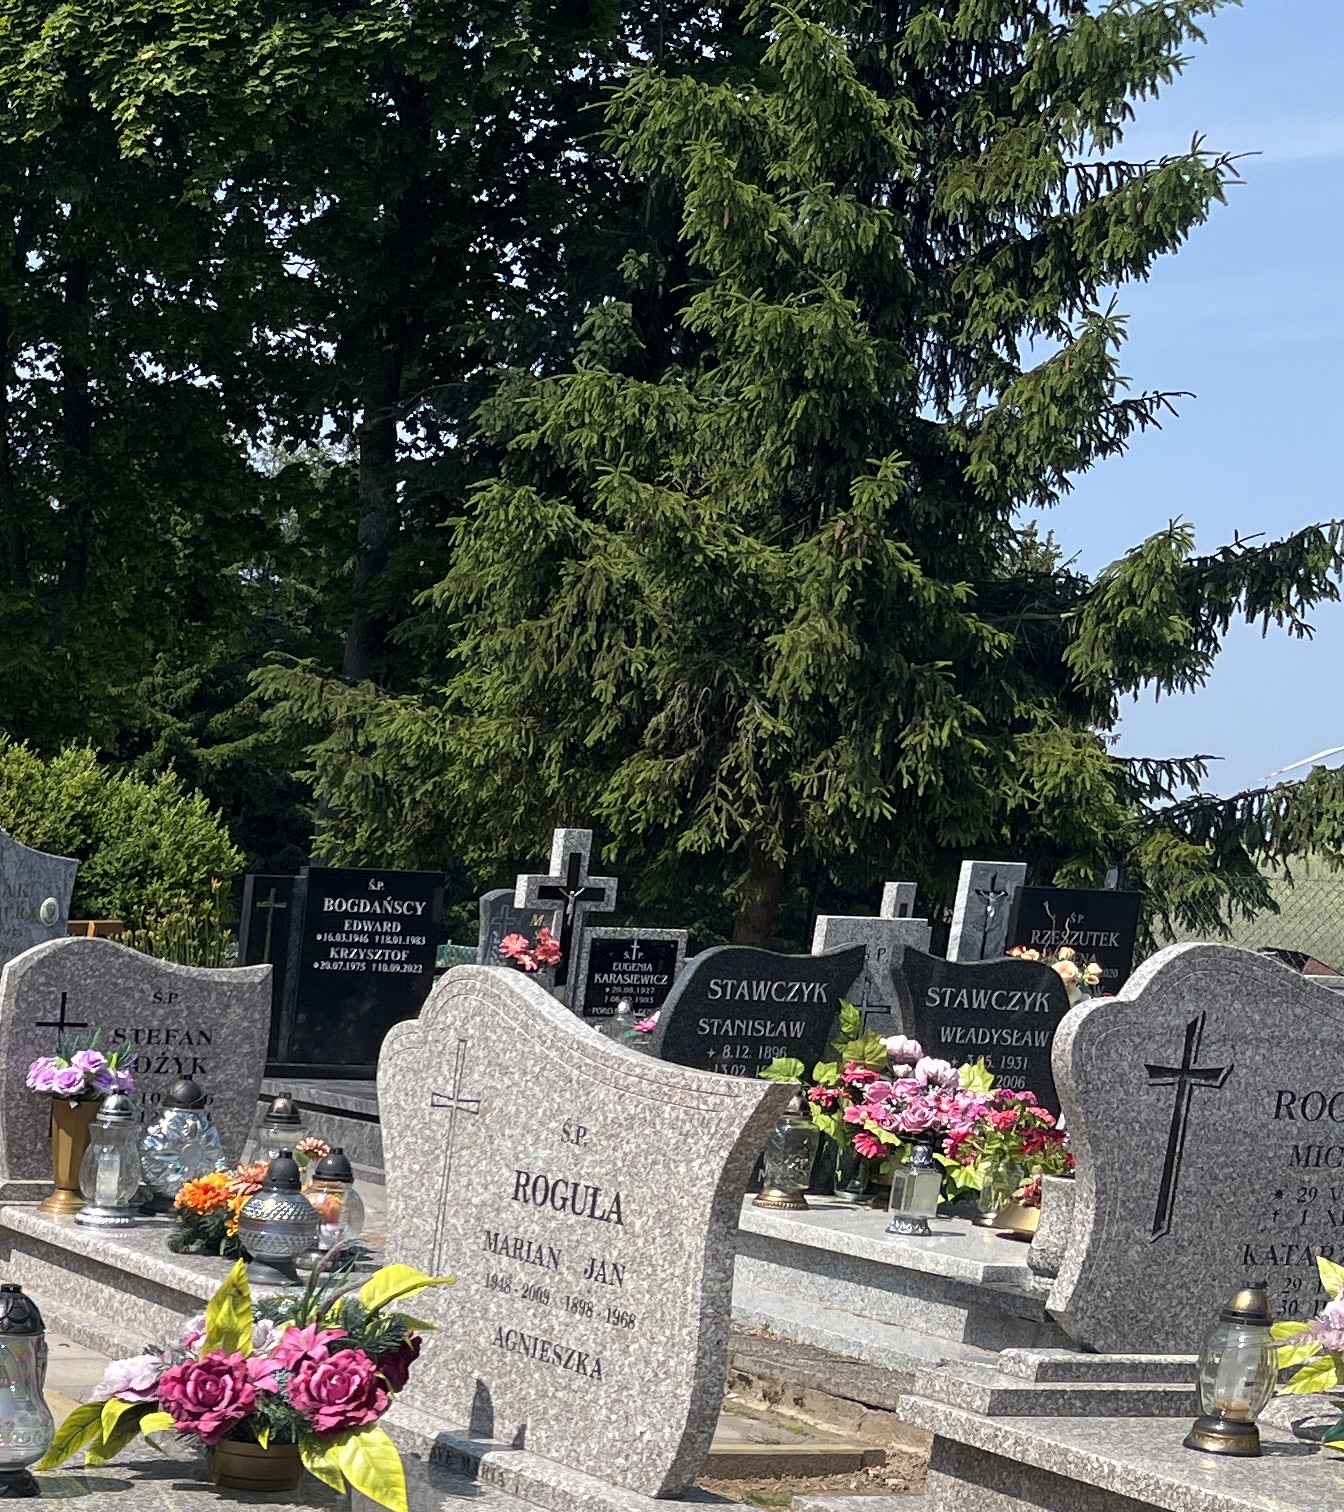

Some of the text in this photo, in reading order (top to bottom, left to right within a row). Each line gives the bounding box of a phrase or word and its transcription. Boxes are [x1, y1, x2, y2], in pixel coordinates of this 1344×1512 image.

[323, 896, 427, 916] BOGDAŃSCY
[343, 919, 402, 933] EDWARD
[1031, 929, 1120, 947] RZESZUTEK
[329, 947, 410, 961] KRZYSZTOF
[612, 962, 653, 972] EUGENIA
[593, 972, 669, 985] KARASIEWICZ
[707, 978, 829, 1004] STAWCZYK
[925, 986, 1051, 1013] STAWCZYK
[112, 1027, 213, 1047] STEFAN
[697, 1017, 807, 1039] STANISŁAW
[940, 1026, 1050, 1047] WŁADYSŁAW
[133, 1051, 208, 1075] OŻYK
[1000, 1055, 1029, 1071] 1931
[996, 1074, 1027, 1090] 2006
[511, 1169, 625, 1227] ROGULA
[482, 1230, 626, 1289] MARIAN JAN
[491, 1326, 604, 1381] AGNIESZKA
